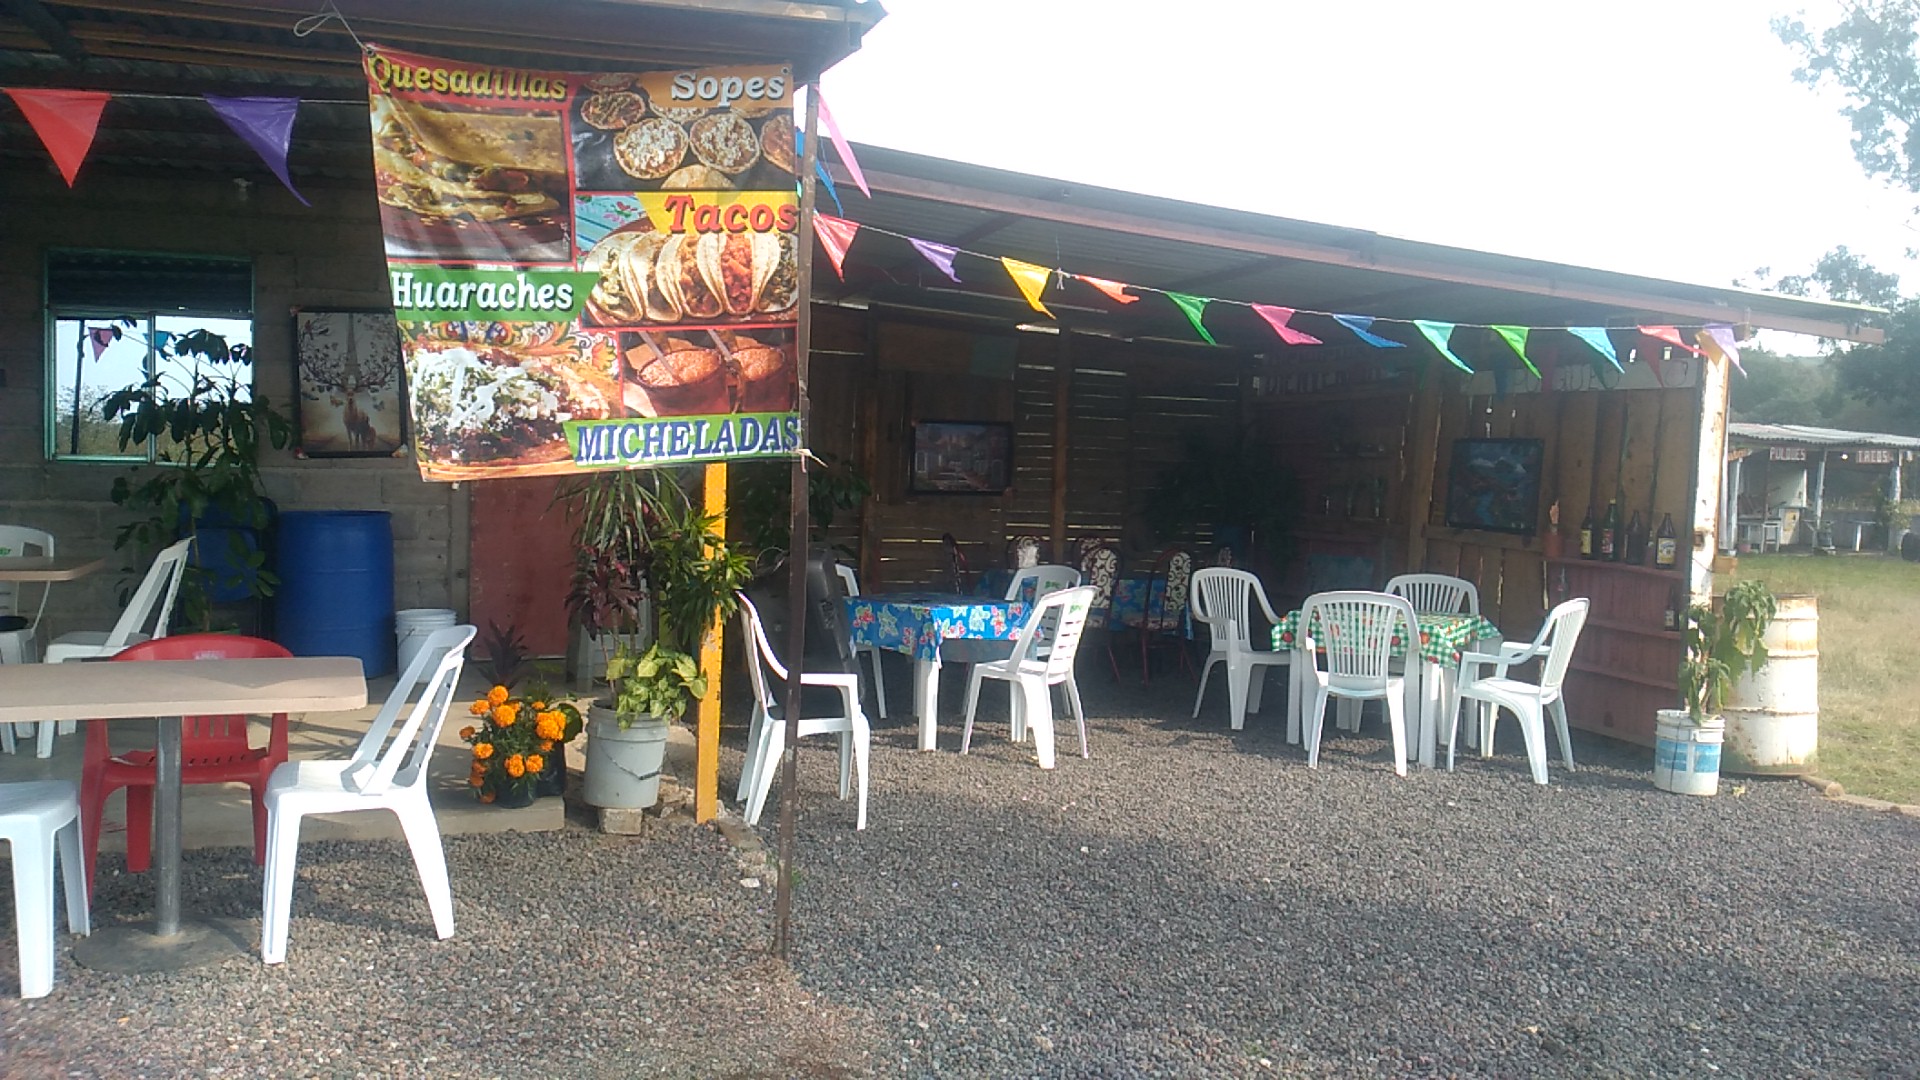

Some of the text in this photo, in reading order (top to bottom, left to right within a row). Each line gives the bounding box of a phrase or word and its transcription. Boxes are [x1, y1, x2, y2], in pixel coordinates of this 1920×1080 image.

[368, 54, 568, 100] Quesadillas
[671, 71, 786, 108] Sopes
[664, 194, 799, 233] Tacos
[390, 271, 574, 311] Huaraches
[576, 416, 800, 466] MICHELADAS
